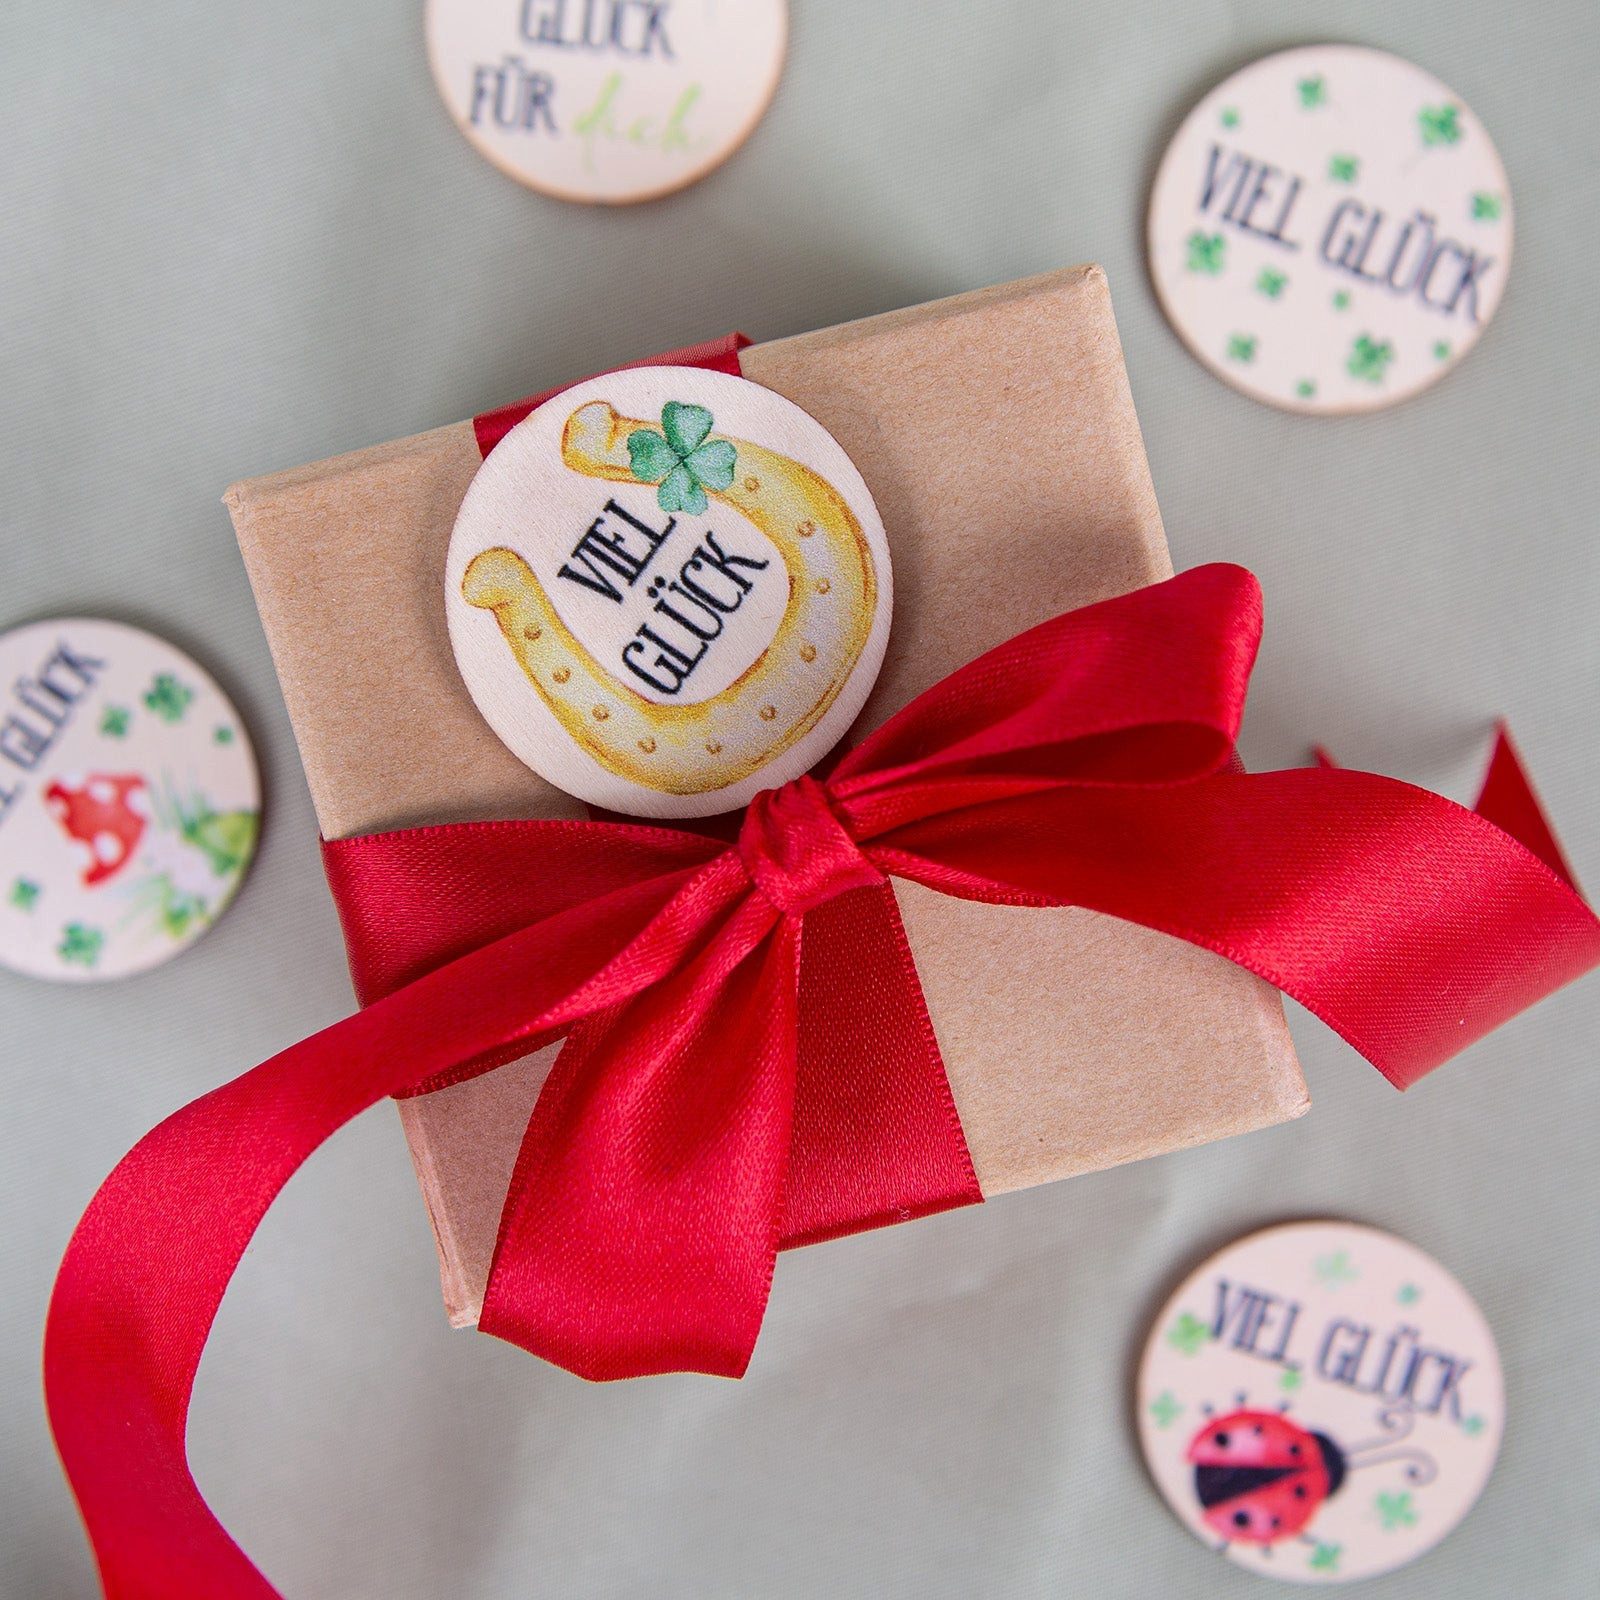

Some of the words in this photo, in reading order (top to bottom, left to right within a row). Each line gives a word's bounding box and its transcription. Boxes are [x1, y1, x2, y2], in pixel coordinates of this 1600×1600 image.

[468, 55, 560, 135] FÜR
[1198, 143, 1305, 252] VIEL
[1317, 199, 1497, 324] GLÜCK
[556, 498, 677, 605] VIEL
[621, 530, 770, 695] GLÜCK
[1210, 1279, 1303, 1371] VIEL
[1314, 1315, 1474, 1423] GLÜCK
